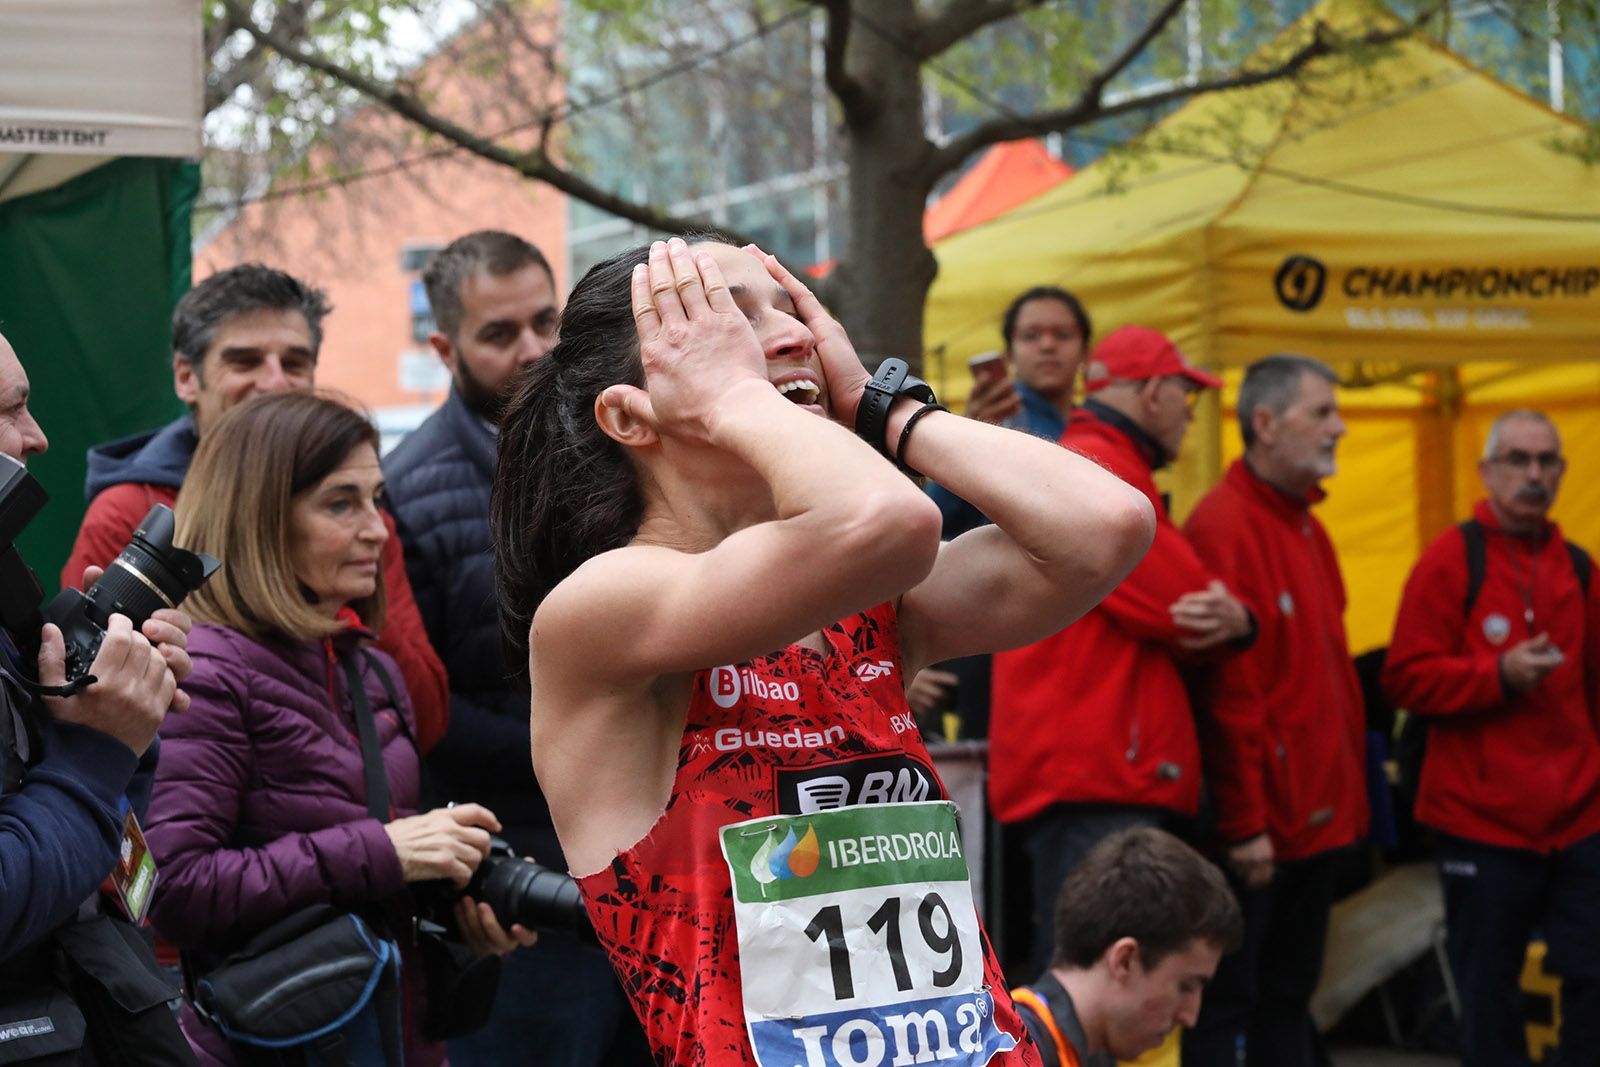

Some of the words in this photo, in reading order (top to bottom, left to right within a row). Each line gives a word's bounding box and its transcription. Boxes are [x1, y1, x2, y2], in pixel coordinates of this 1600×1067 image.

[0, 127, 105, 146] ASTERTENT
[1343, 266, 1600, 298] CHAMPIONCHIP
[714, 667, 799, 703] Bilbao
[715, 725, 845, 751] Guedan
[828, 831, 962, 869] IBERDROLA
[804, 892, 963, 1000] 119
